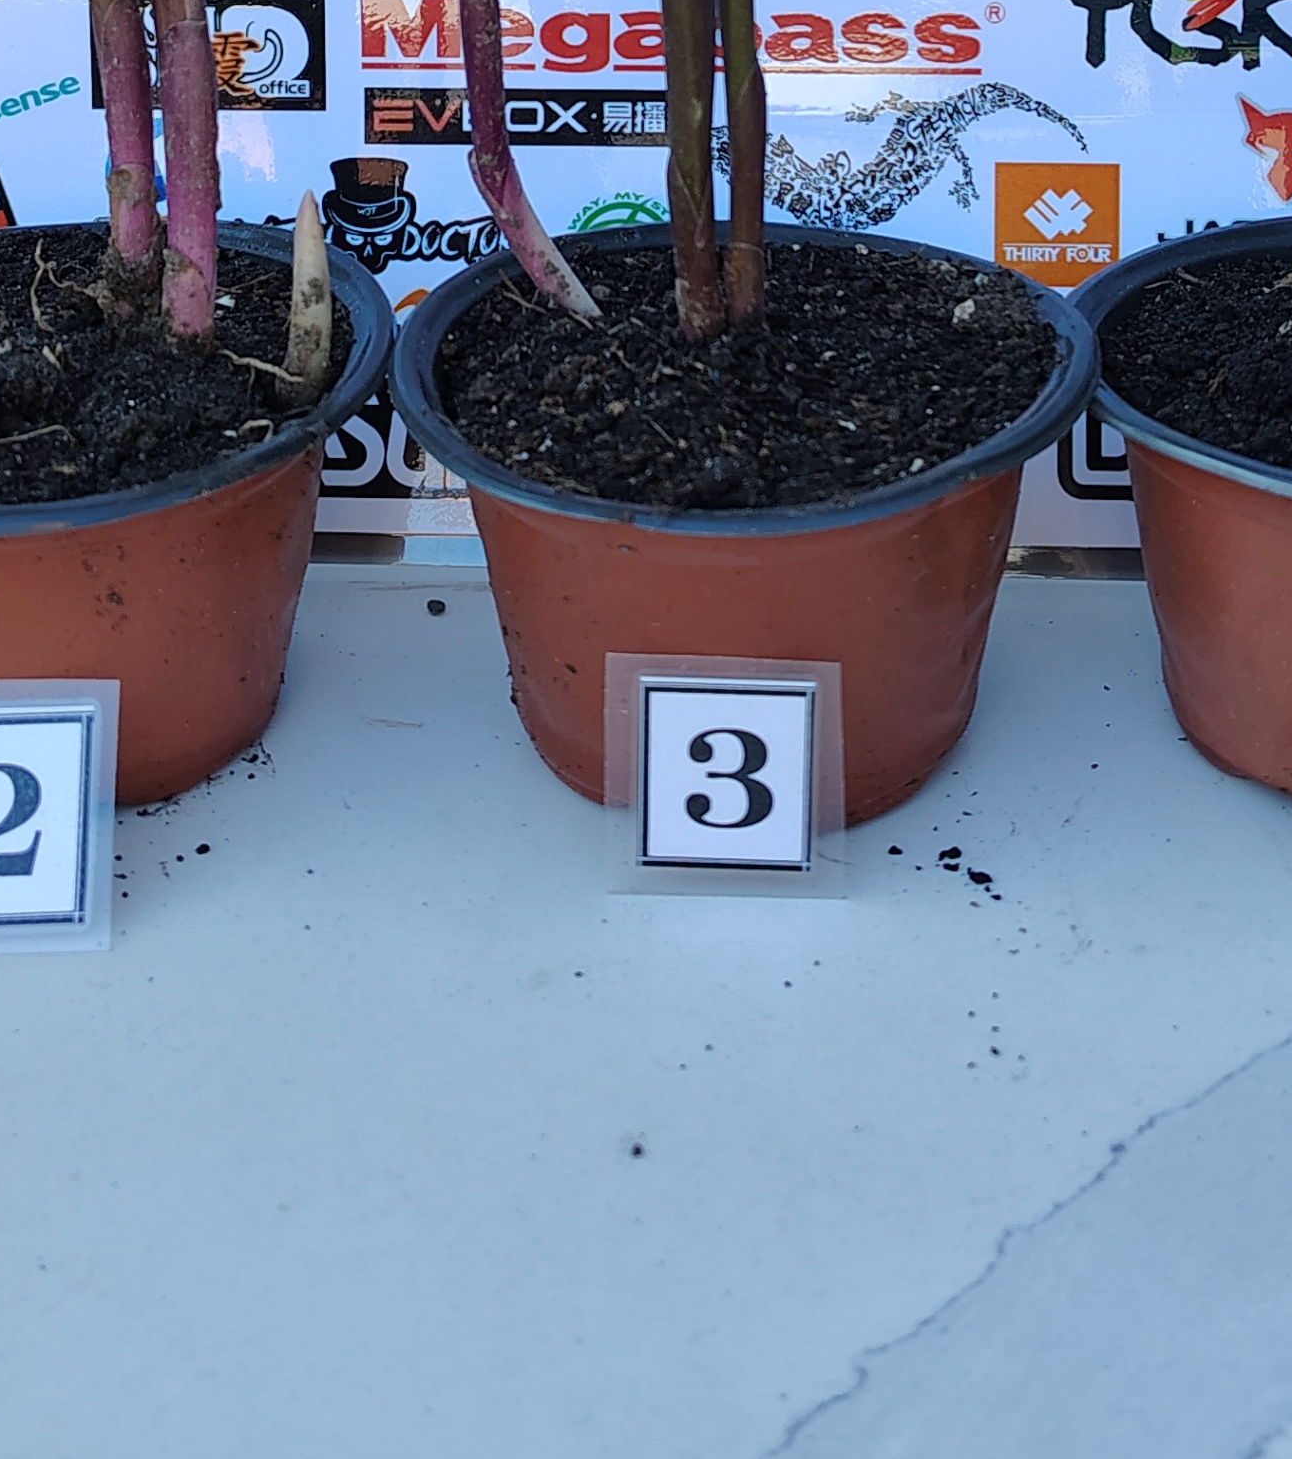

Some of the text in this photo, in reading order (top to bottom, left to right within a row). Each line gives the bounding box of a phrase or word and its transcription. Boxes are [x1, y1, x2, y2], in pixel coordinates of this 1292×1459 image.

[259, 80, 307, 95] office
[1003, 243, 1112, 263] THIRTY FOUR
[687, 729, 773, 829] 3
